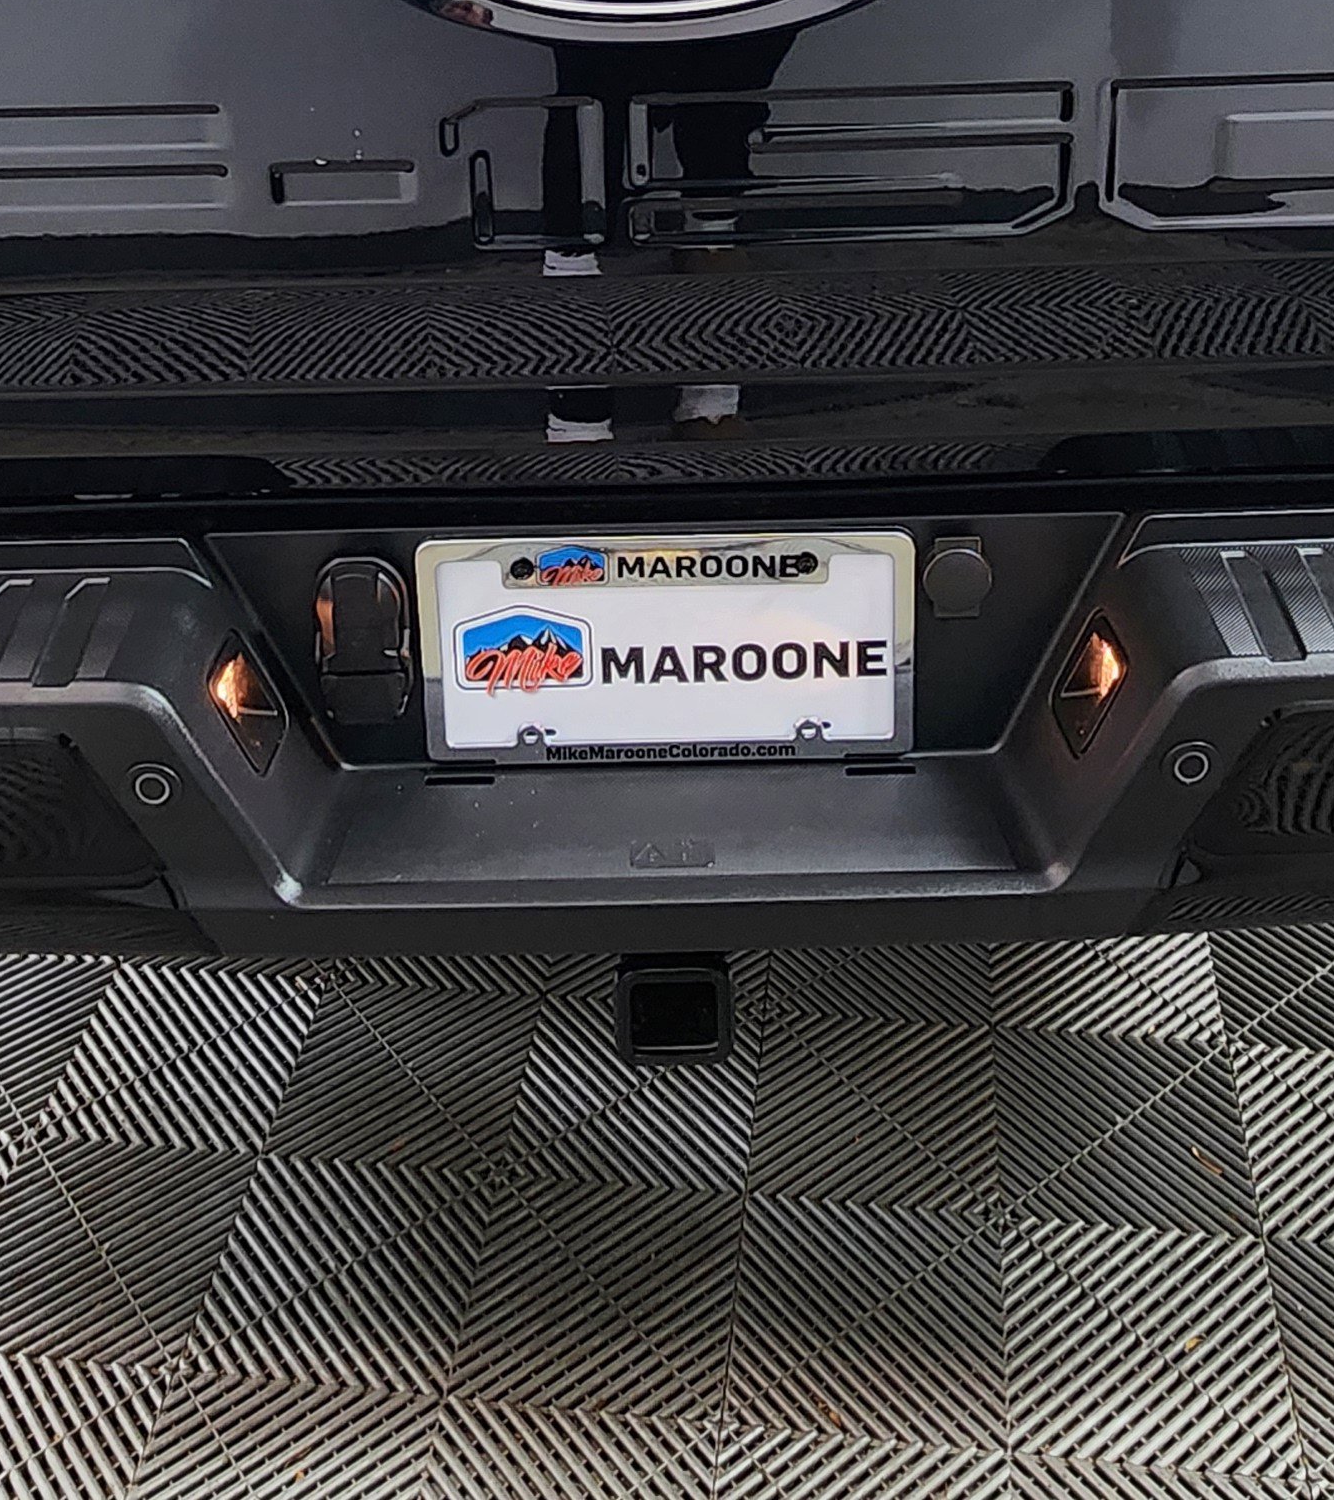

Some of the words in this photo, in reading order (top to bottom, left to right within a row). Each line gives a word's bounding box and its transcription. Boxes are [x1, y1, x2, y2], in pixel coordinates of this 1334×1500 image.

[541, 563, 605, 588] Mike
[617, 554, 802, 578] MAROONE
[466, 642, 584, 697] Mike
[600, 640, 888, 685] MAROONE
[546, 743, 796, 762] MikeMarooneColorado.com
